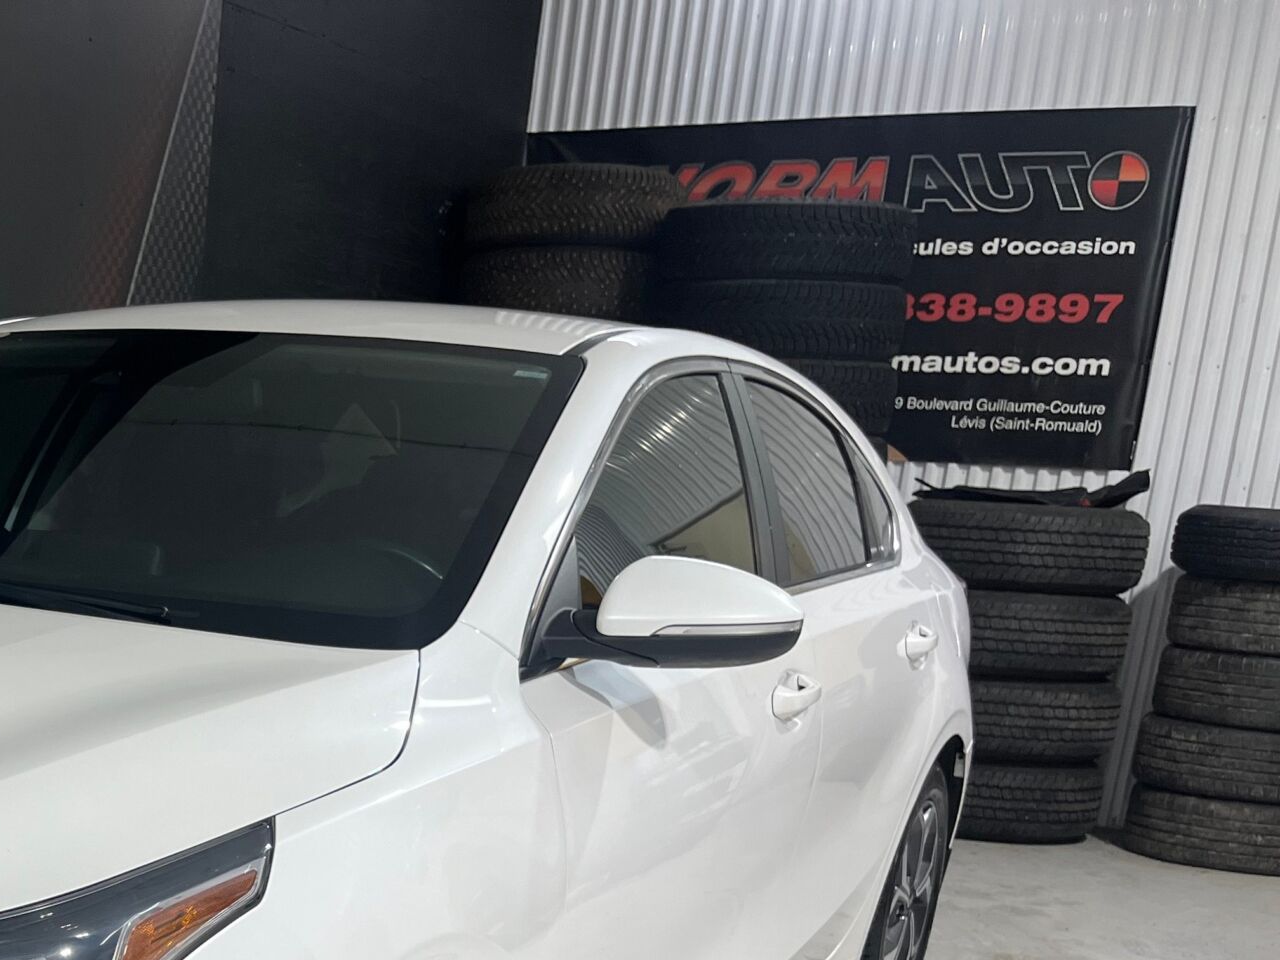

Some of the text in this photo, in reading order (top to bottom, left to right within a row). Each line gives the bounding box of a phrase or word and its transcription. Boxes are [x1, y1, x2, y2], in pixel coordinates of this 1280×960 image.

[904, 151, 1150, 213] AUTO
[982, 237, 1136, 256] d'occasion
[907, 396, 972, 412] Boulevard
[976, 398, 1106, 416] Guillaume-Couture
[950, 415, 1103, 436] Lévis (Saint-Romuald)
